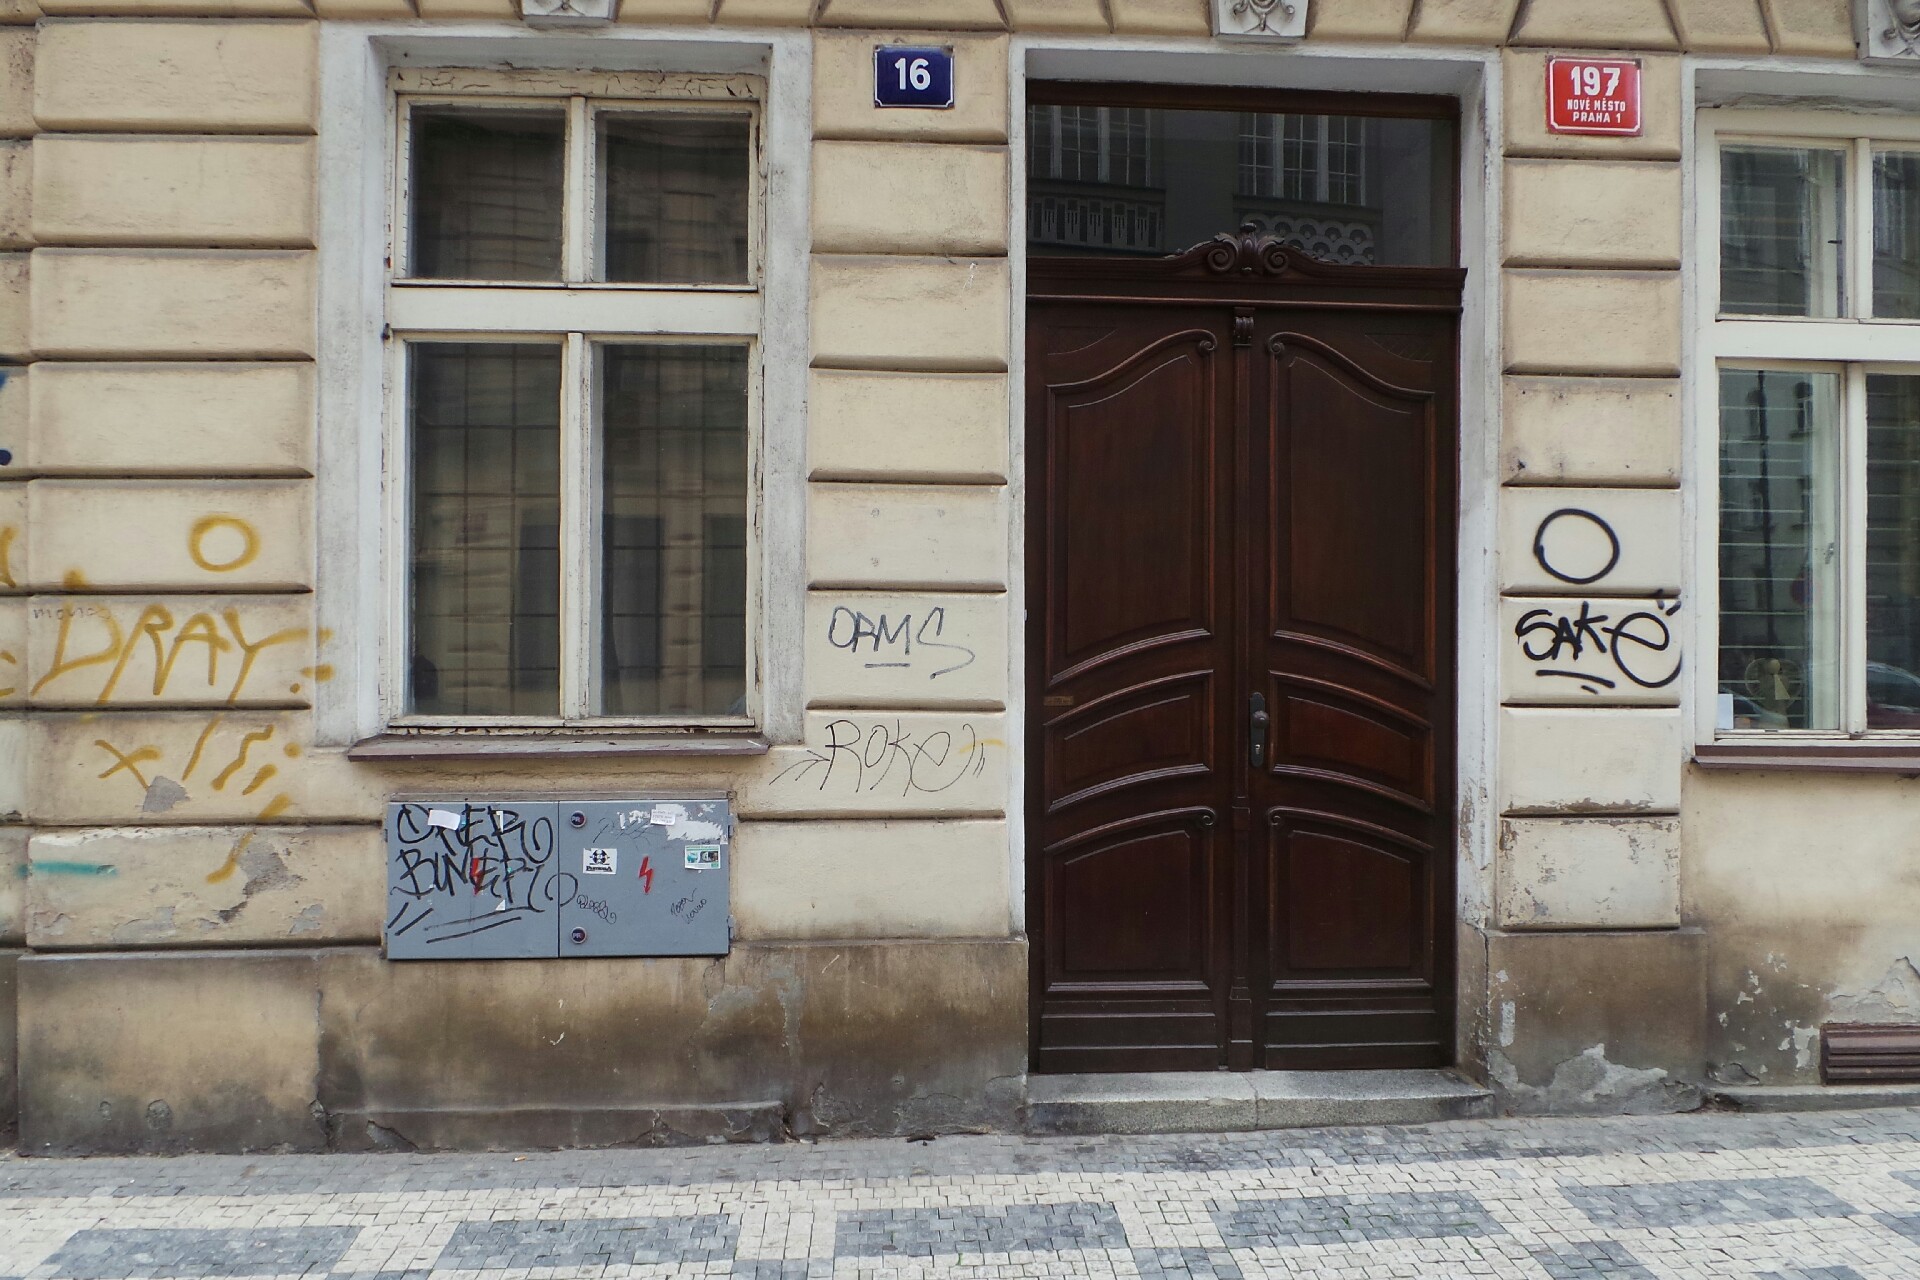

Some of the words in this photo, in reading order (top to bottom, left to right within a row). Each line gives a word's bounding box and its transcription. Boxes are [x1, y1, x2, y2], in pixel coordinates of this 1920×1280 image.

[894, 57, 931, 91] 16
[1570, 65, 1621, 97] 197
[1567, 97, 1591, 111] NOVÉ
[1594, 98, 1626, 112] MĚSTO
[1572, 111, 1611, 123] PRAHA
[1616, 113, 1621, 124] 1
